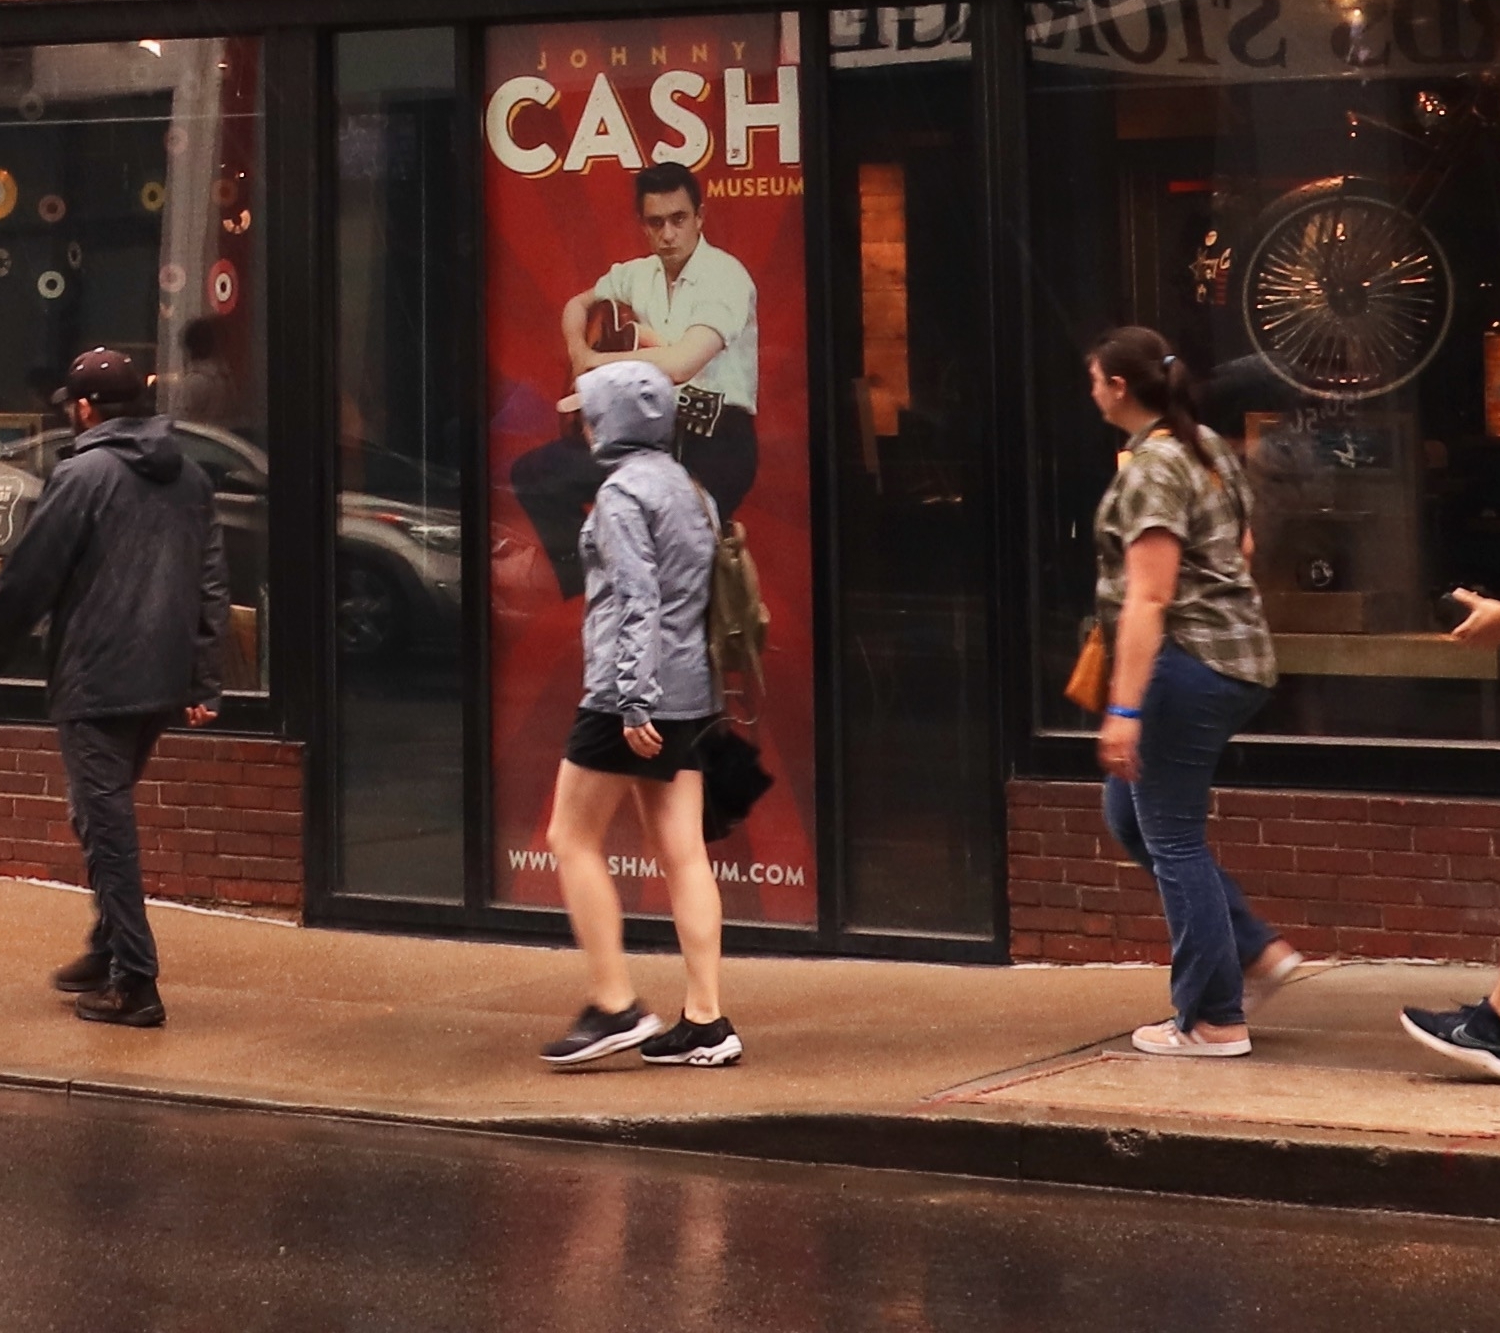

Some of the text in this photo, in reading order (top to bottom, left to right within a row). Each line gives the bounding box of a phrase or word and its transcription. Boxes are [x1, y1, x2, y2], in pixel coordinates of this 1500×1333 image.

[536, 41, 746, 71] JOHNNY
[485, 65, 801, 176] CASH
[706, 176, 805, 198] MUSEUM
